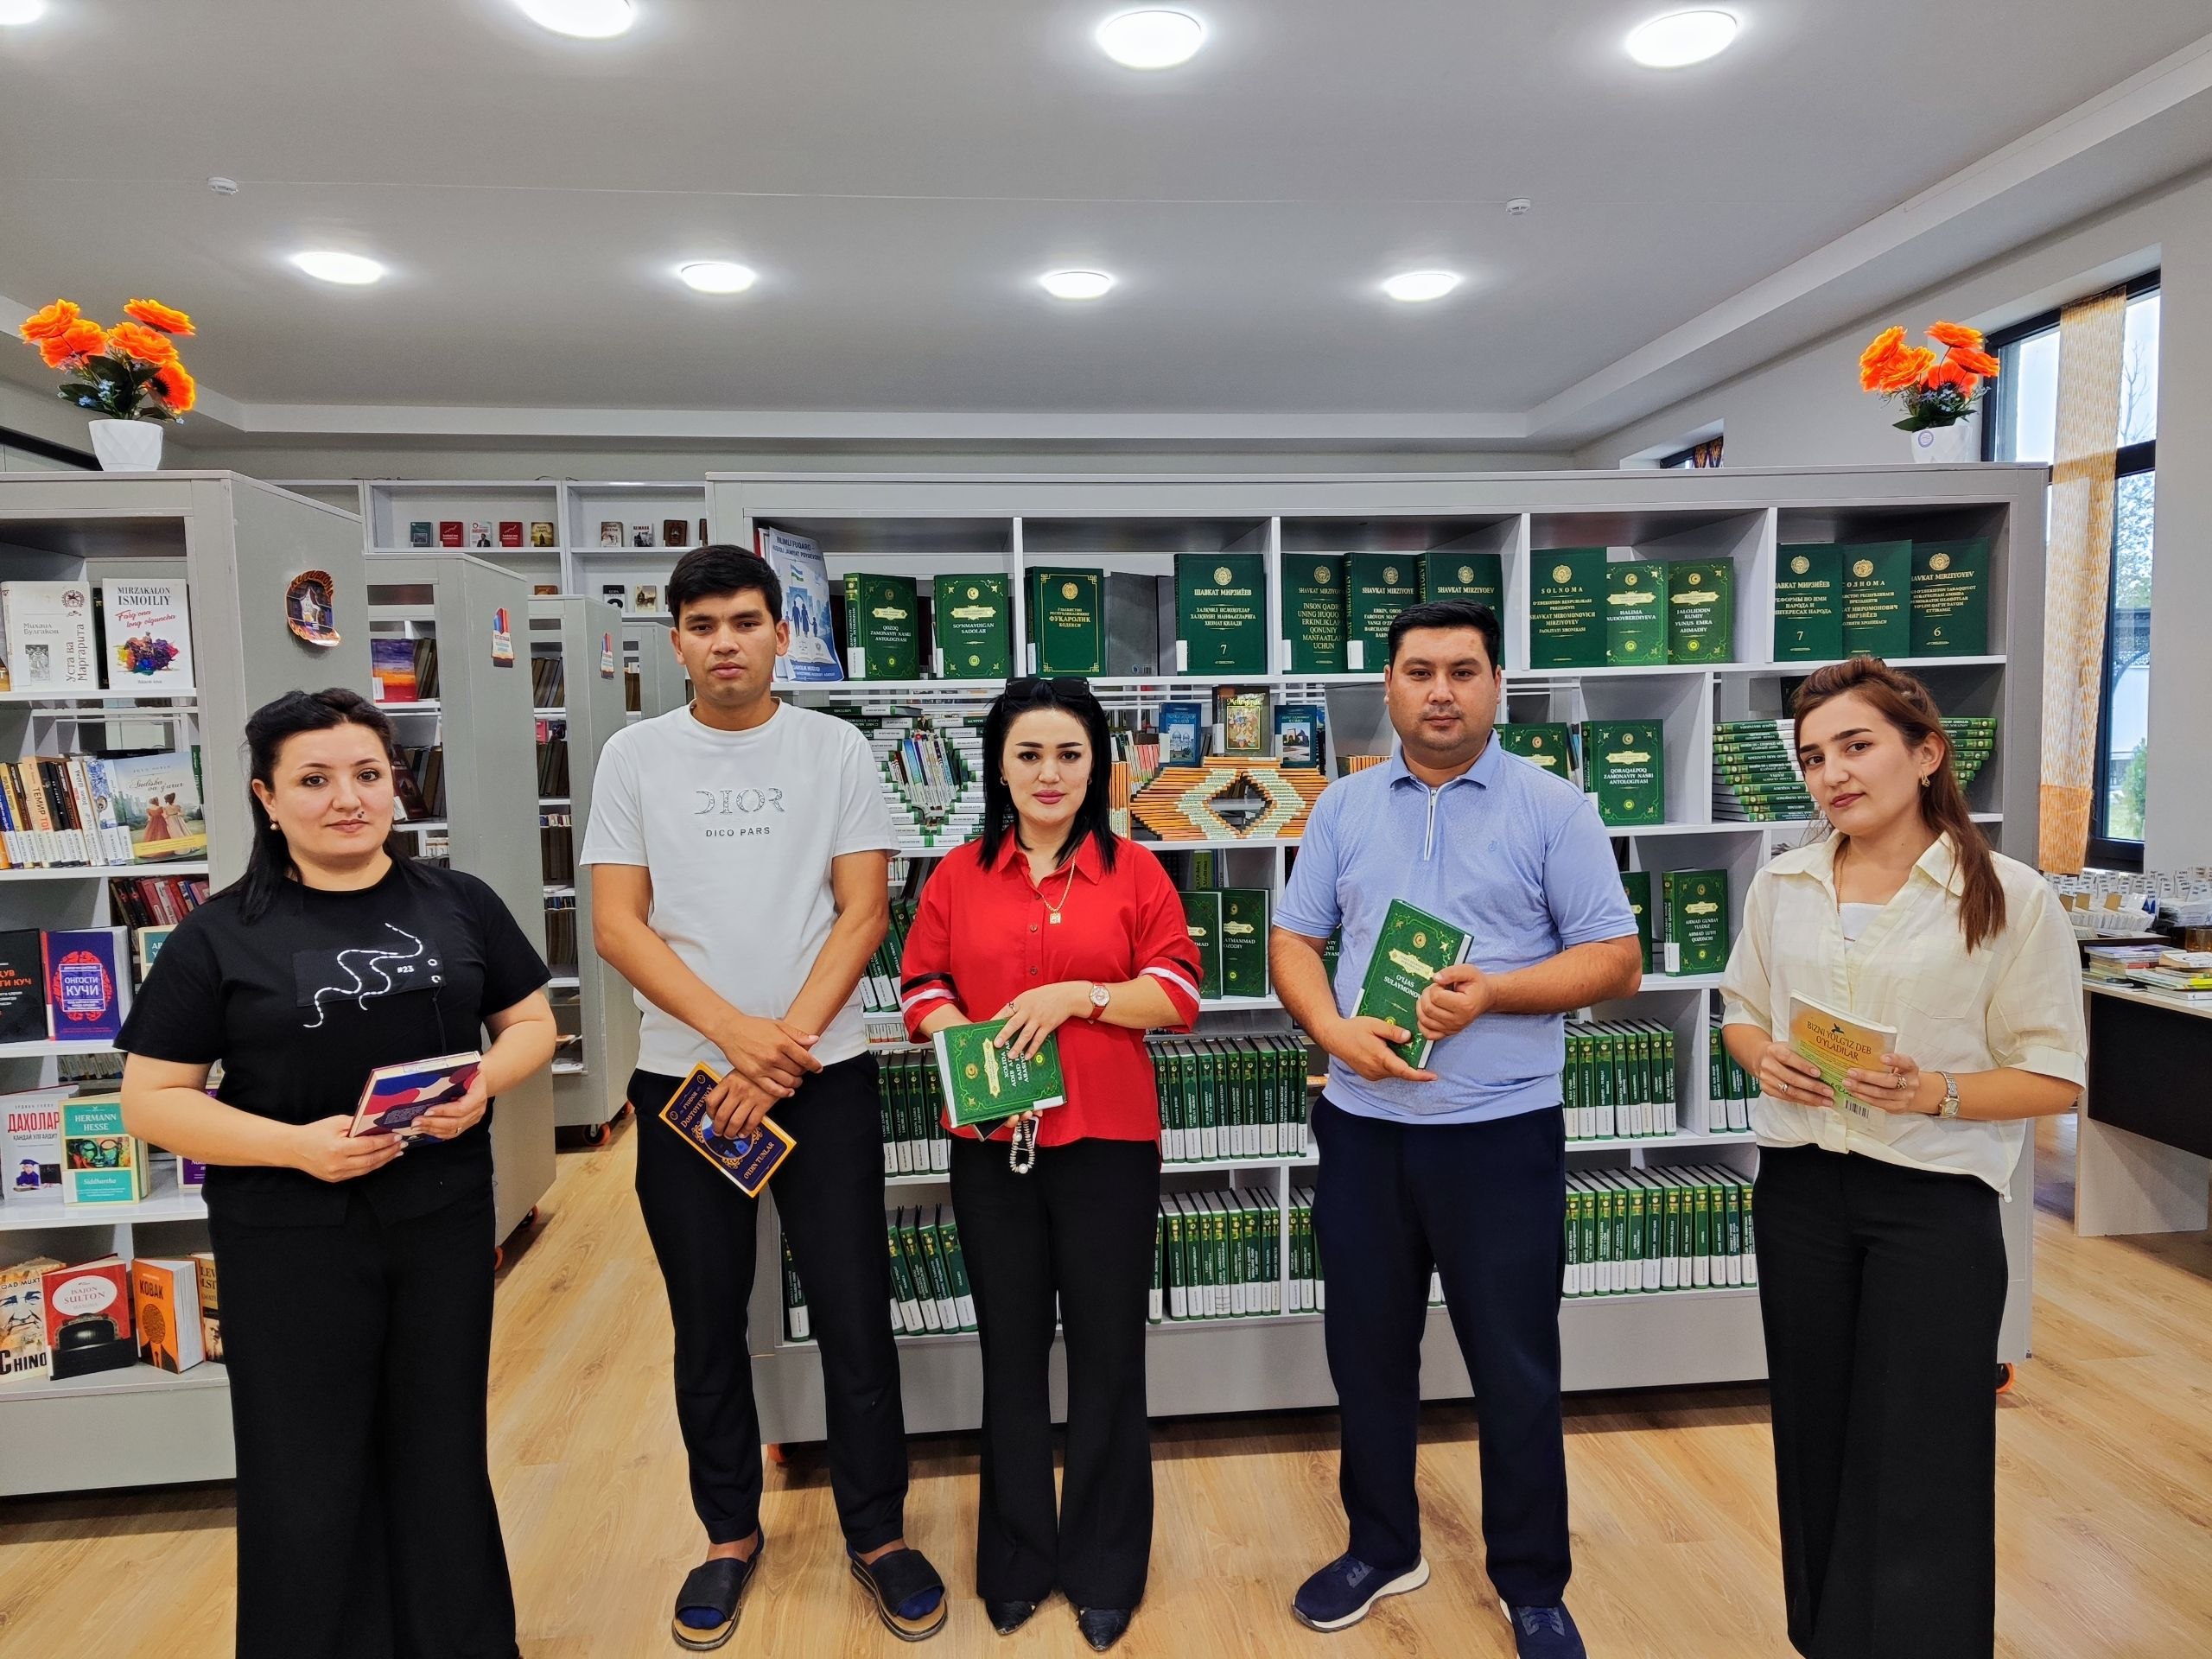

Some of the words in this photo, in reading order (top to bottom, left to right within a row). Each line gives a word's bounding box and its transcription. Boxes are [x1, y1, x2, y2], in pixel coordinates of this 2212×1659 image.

[1935, 571, 1975, 581] MIRZIYOYEV
[1797, 580, 1831, 589] МИРЗИЁЕВ
[117, 587, 171, 595] MIRZAKALON
[1220, 588, 1252, 596] МИРЗИЁЕВ
[118, 595, 171, 606] ISMOILIY
[1309, 626, 1337, 635] QONUNIY
[1796, 630, 1804, 641] 7
[1933, 626, 1942, 637] 6
[67, 641, 73, 655] ва
[1220, 644, 1227, 655] 7
[1313, 642, 1335, 650] UCHUN
[77, 624, 88, 681] Маргарита
[66, 657, 76, 682] Уста
[32, 788, 46, 815] ТЕМИР
[694, 788, 785, 814] DIOR
[706, 829, 734, 837] DICO
[740, 826, 771, 836] PARS
[397, 965, 415, 973] #23
[13, 978, 32, 986] КУЧ
[66, 985, 99, 997] КУЧИ
[1807, 1021, 1826, 1038] BIZNI
[1856, 1042, 1872, 1055] DEB
[1815, 1036, 1859, 1061] O'YLADILAR
[1001, 1051, 1009, 1078] XOLIDA
[683, 1091, 698, 1110] FYODOR
[8, 1112, 60, 1133] ДАҲОЛАР
[74, 1113, 117, 1122] HERMANN
[83, 1123, 109, 1132] HESSE
[744, 1160, 760, 1179] OYDIN
[755, 1141, 775, 1166] TUNLAR
[83, 1177, 117, 1185] Siddhartha
[71, 1286, 98, 1295] ISAJON
[139, 1279, 164, 1300] KOBAK
[64, 1292, 106, 1305] SULTON
